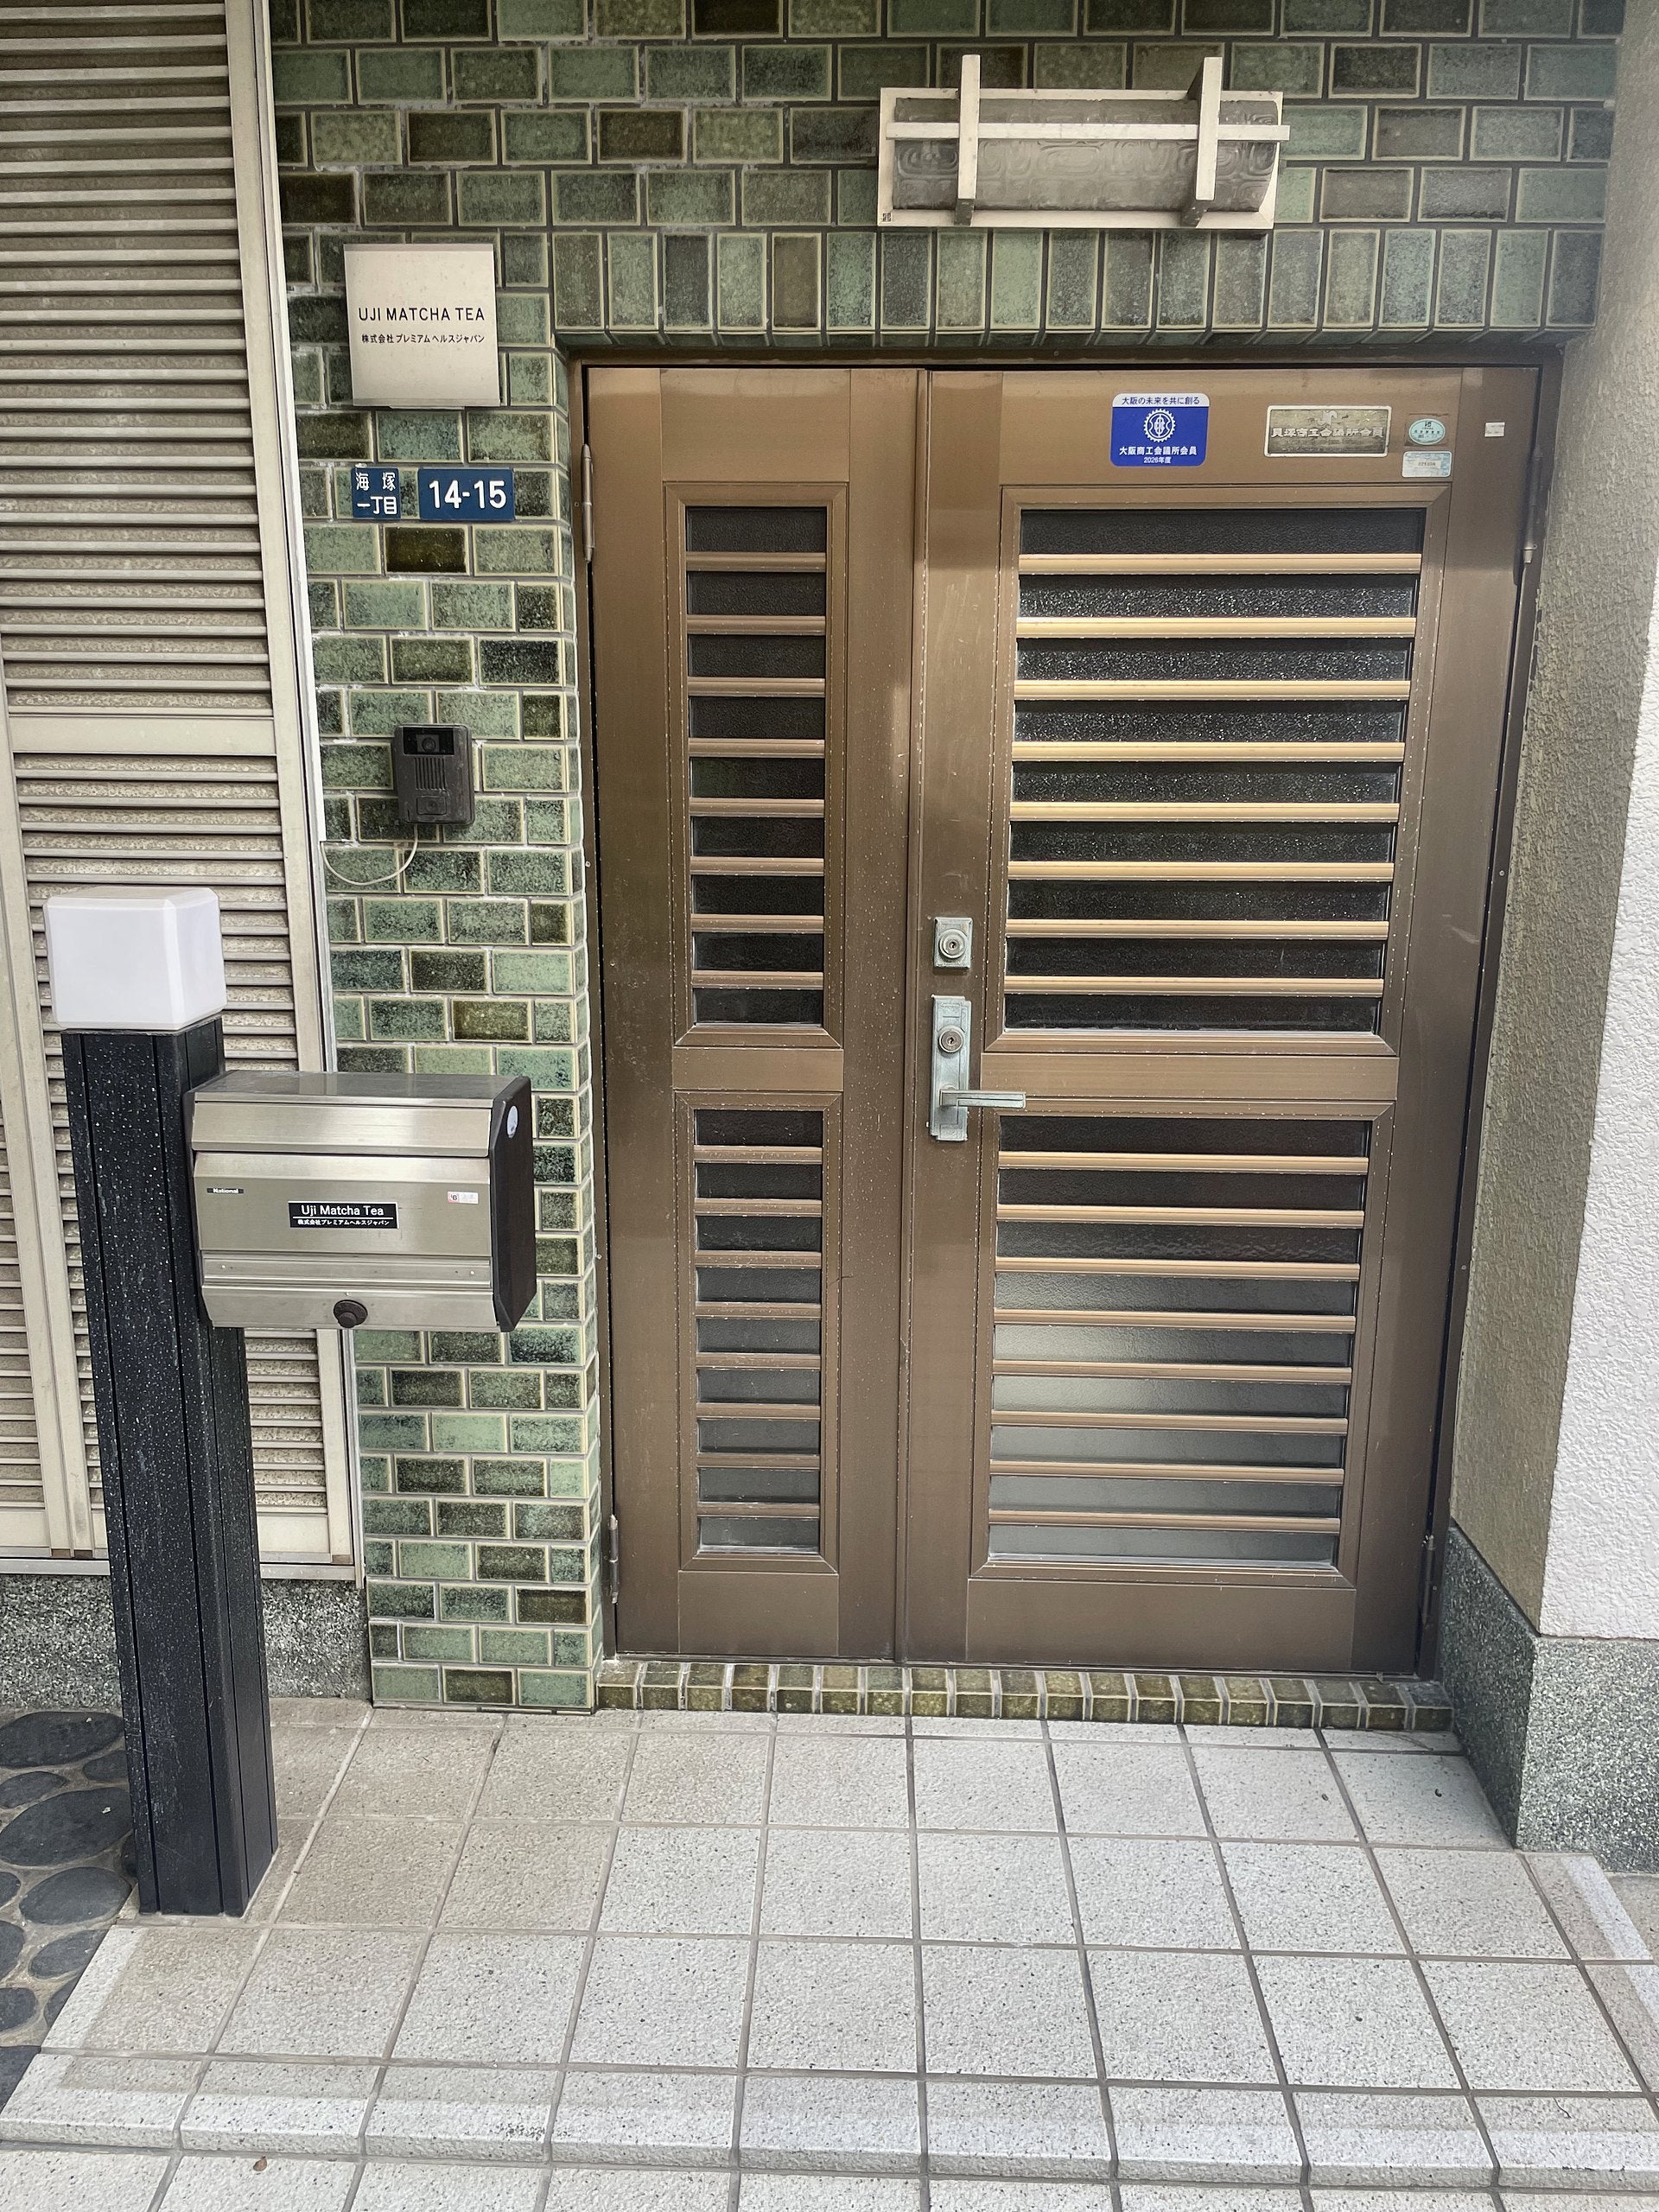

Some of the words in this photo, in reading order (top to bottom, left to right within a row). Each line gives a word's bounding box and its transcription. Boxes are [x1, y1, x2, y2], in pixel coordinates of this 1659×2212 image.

[359, 307, 381, 321] UJI
[386, 307, 450, 321] MATCHA
[455, 307, 485, 321] TEA
[361, 334, 485, 344] 株式会社プレミアムヘルスジャパン
[1122, 397, 1200, 405] 大阪の未来を共に創る
[1119, 446, 1197, 455] 大阪商工会議所会員
[429, 480, 507, 509] 14-15
[357, 496, 397, 515] 一丁目
[301, 1205, 316, 1217] Uji
[320, 1205, 360, 1216] Matcha
[363, 1205, 385, 1216] Tea
